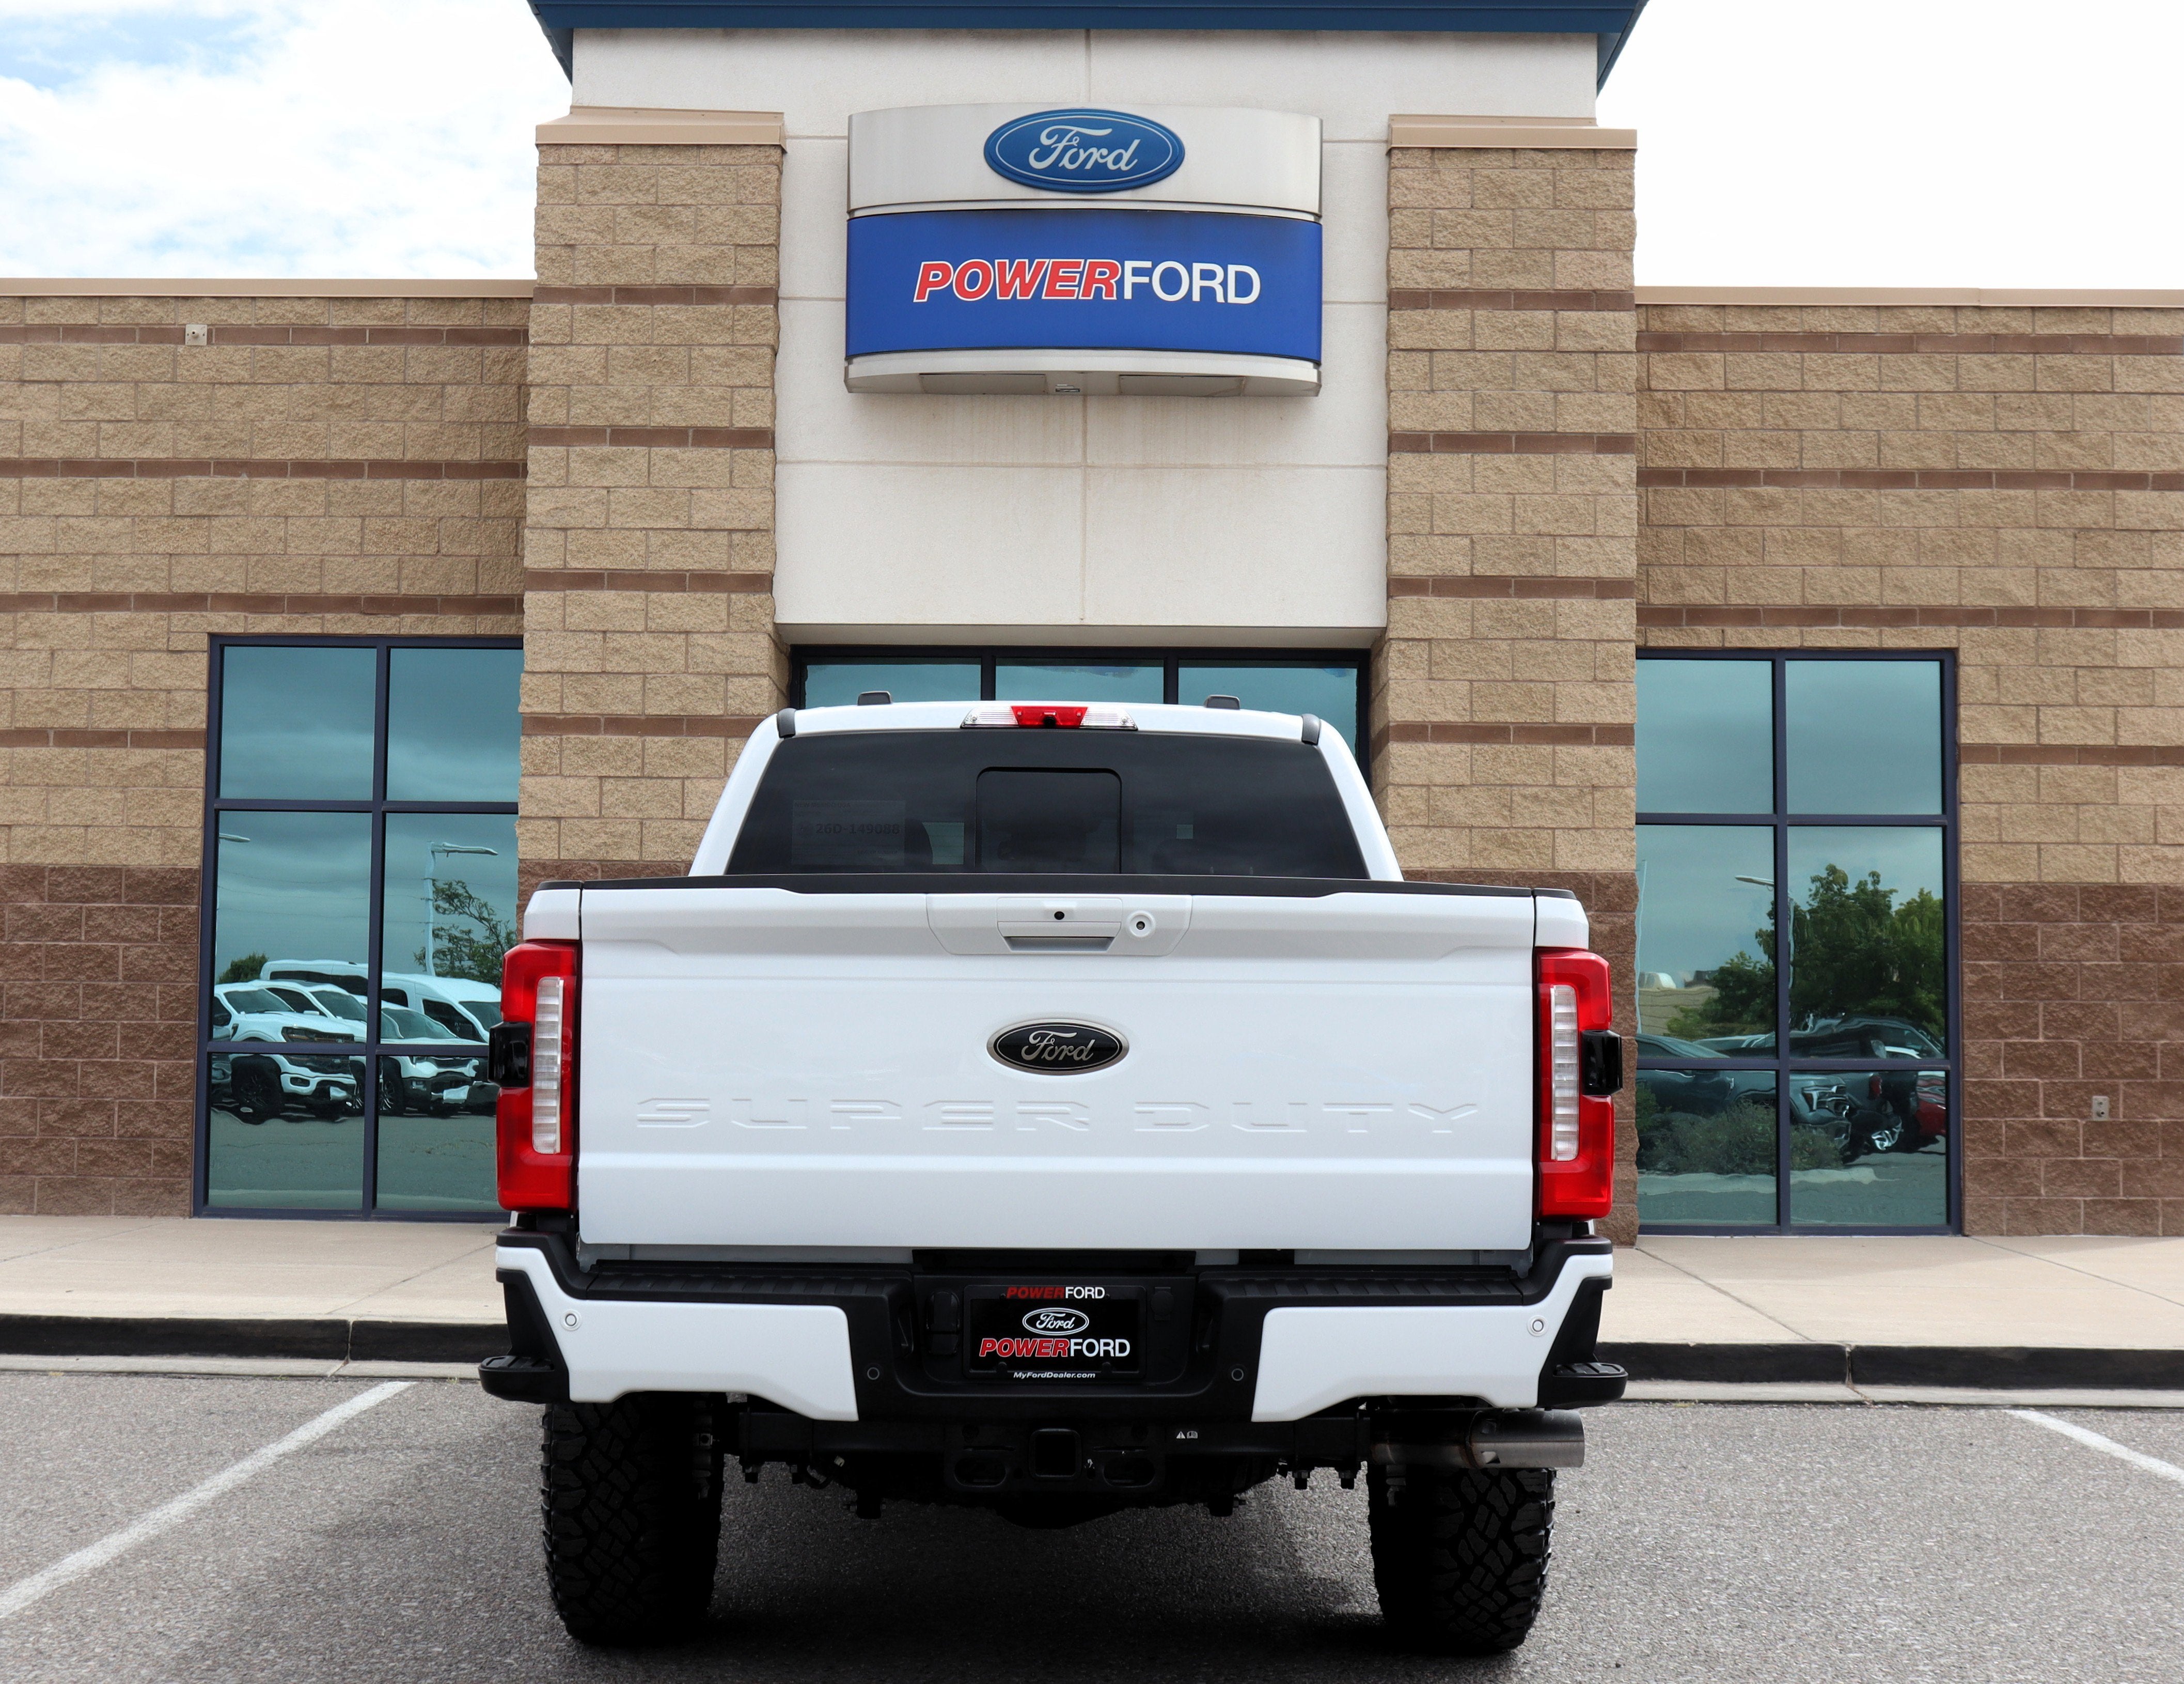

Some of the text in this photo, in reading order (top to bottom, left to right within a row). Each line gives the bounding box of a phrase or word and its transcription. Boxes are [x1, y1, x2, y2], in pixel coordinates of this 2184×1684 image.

[1029, 124, 1140, 171] Ford
[913, 259, 1261, 304] POWERFORD
[1020, 1030, 1096, 1061] Ford
[636, 1098, 1479, 1133] SUPER DUTY
[1007, 1286, 1105, 1299] POWERFORD
[1036, 1313, 1076, 1329] Ford
[979, 1338, 1130, 1357] POWERFORD
